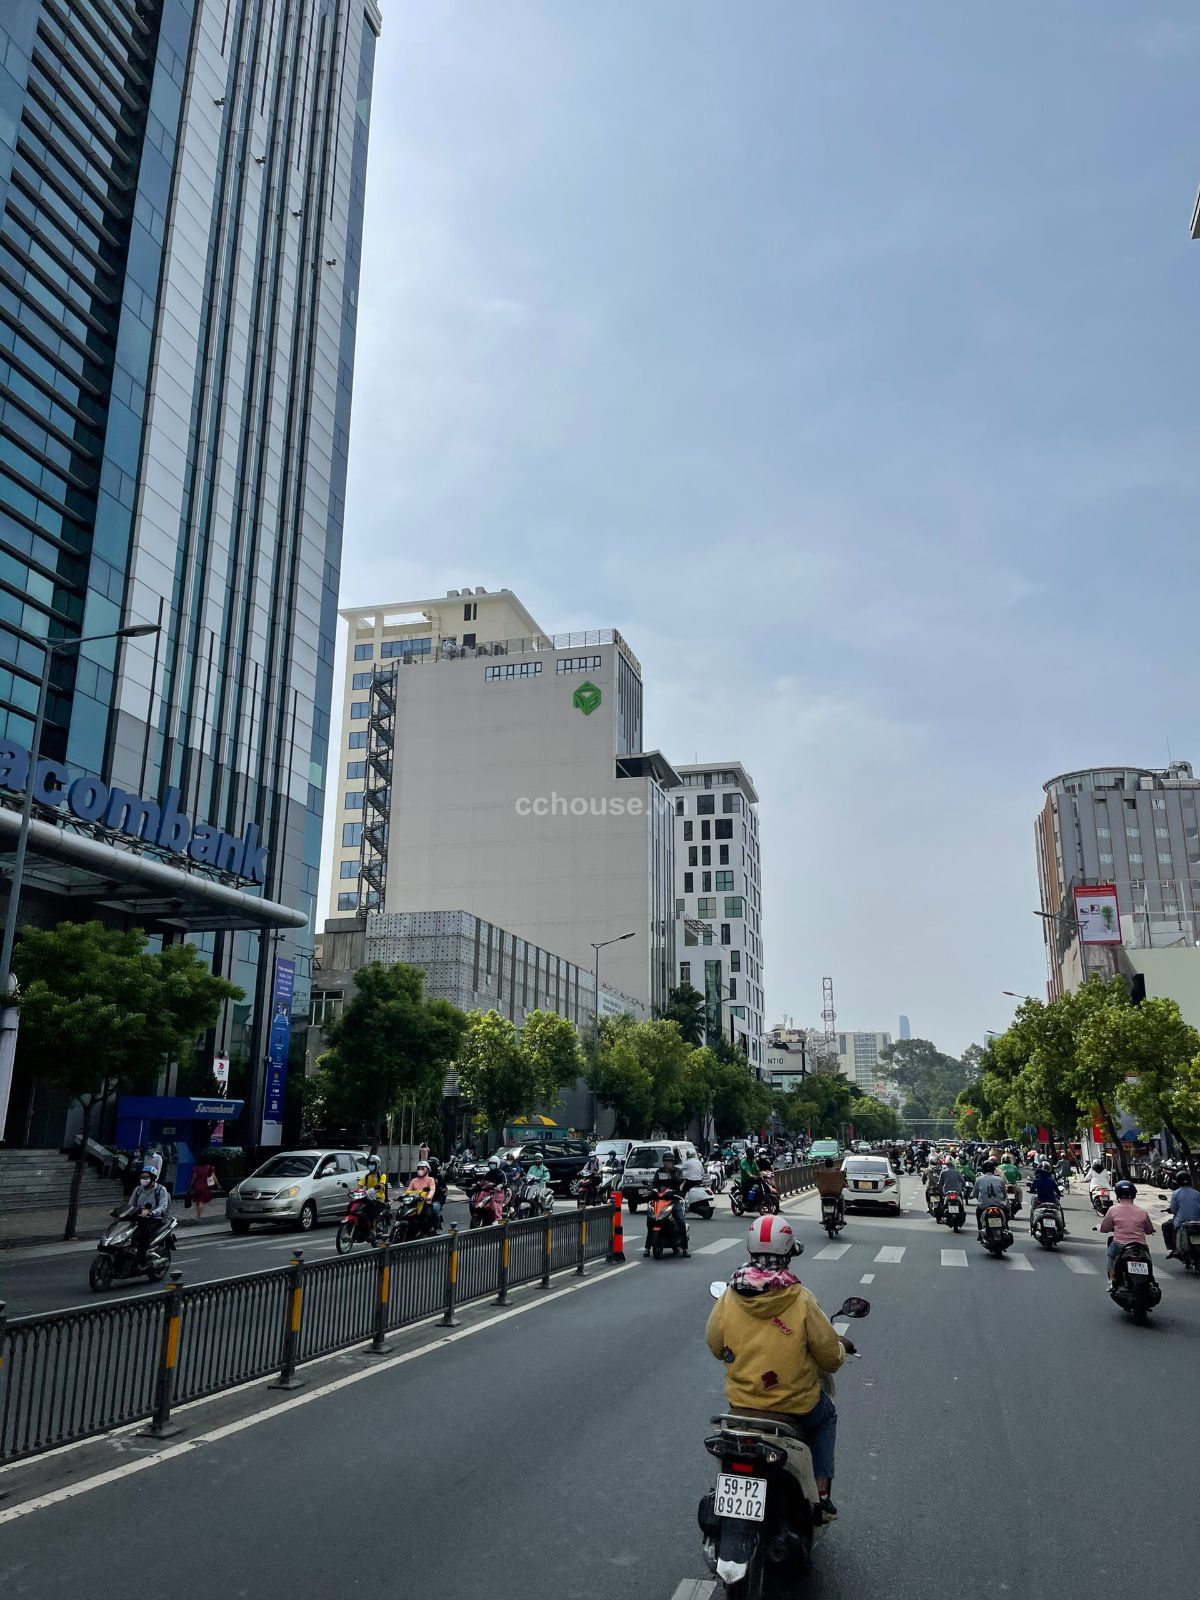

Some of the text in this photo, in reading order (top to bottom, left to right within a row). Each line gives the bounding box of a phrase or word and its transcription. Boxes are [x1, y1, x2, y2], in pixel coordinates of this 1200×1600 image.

[195, 1103, 235, 1114] Sacombank
[724, 1478, 759, 1498] 59-P2
[718, 1496, 762, 1517] 892.02
